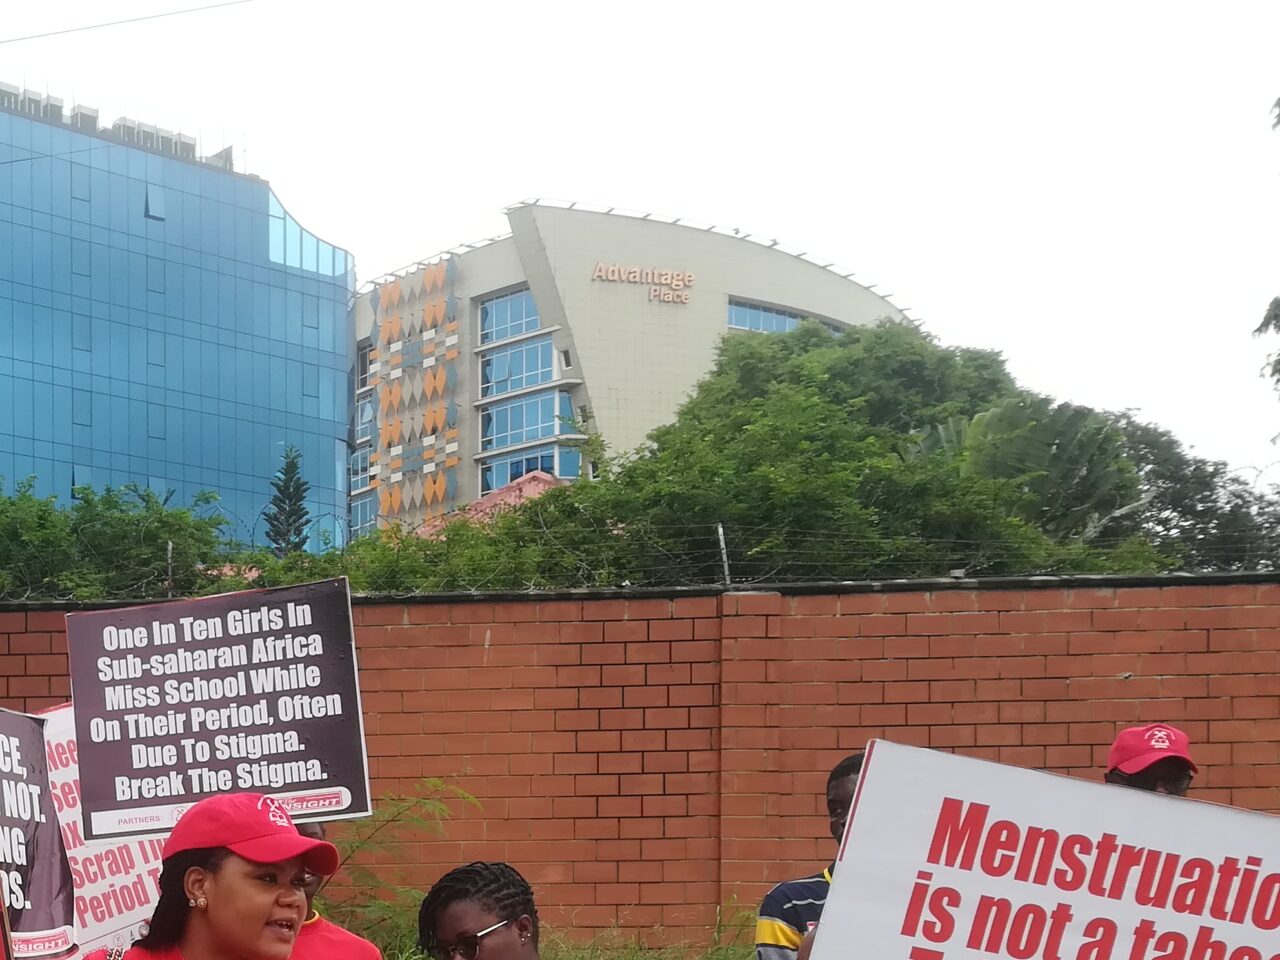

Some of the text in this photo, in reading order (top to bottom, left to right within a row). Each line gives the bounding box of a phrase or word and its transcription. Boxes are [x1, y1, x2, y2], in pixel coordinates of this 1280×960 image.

[592, 261, 695, 290] Advantage
[649, 286, 690, 304] Place
[103, 602, 312, 651] One In Ten Girls In
[97, 633, 323, 682] Sub-saharan Africa
[105, 663, 321, 711] Miss School While
[90, 693, 343, 743] On Their Period, Often
[131, 730, 305, 769] Due To Stigma.
[3, 779, 47, 823] NOT.
[115, 772, 185, 802] Break
[188, 767, 233, 794] The
[236, 758, 328, 790] Stigma.
[70, 843, 136, 889] Scrap
[75, 870, 151, 929] Period
[901, 871, 963, 943] is
